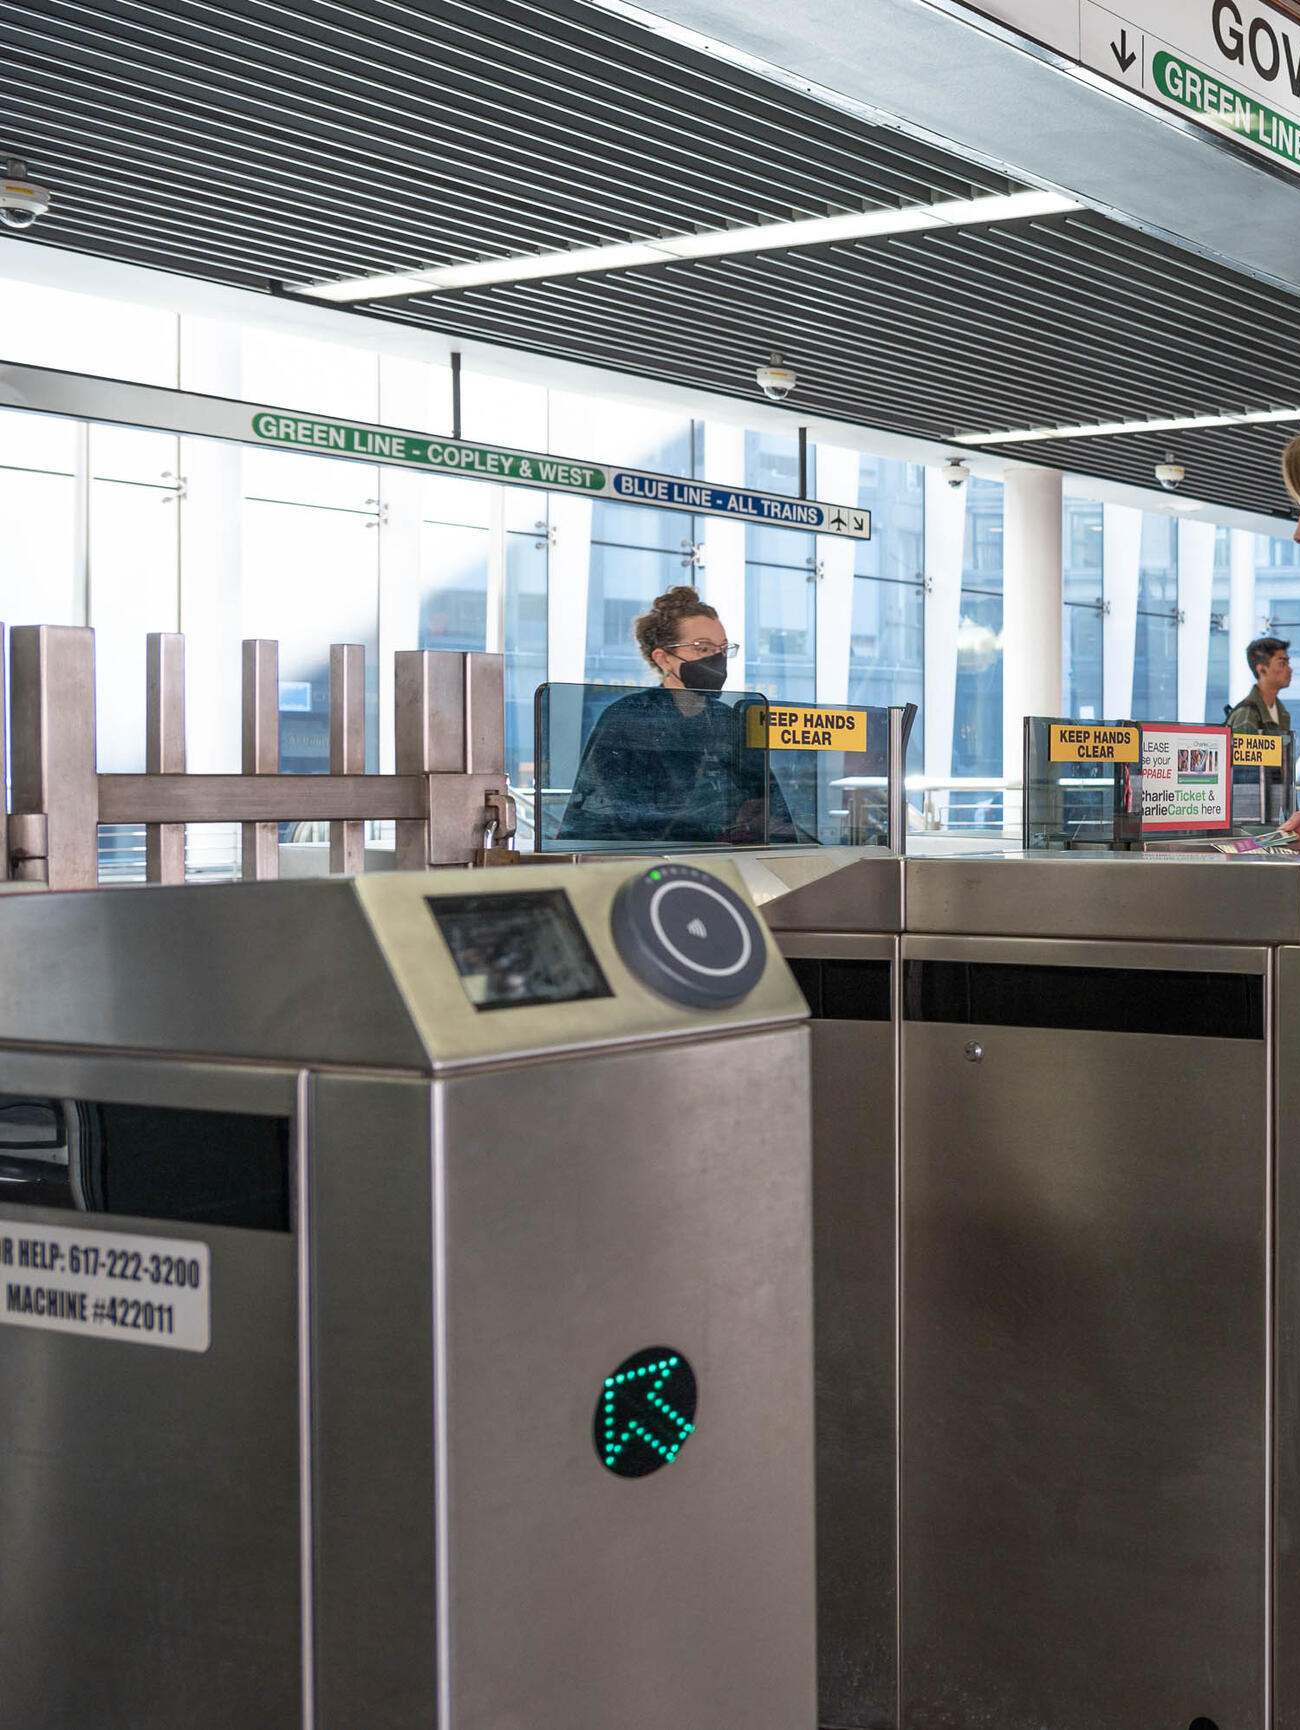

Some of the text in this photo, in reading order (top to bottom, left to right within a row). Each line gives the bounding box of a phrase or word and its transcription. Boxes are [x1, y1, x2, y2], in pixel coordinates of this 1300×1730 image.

[1164, 60, 1251, 134] GREEN
[258, 415, 346, 449] GREEN
[353, 430, 406, 458] LINE
[427, 444, 514, 475] COPLEY
[519, 458, 534, 478] &
[539, 463, 595, 488] WEST
[620, 475, 669, 500] BLUE
[673, 486, 712, 507] LINE
[726, 494, 758, 515] ALL
[760, 499, 819, 524] TRAINS
[803, 713, 856, 730] HANDS
[781, 729, 832, 746] CLEAR
[1059, 729, 1131, 745] KEEP HANDS
[1233, 737, 1276, 751] EP HANDS
[1077, 744, 1115, 758] CLEAR
[1143, 742, 1169, 753] LEASE
[1141, 756, 1171, 767] se your
[1233, 750, 1263, 763] CLEAR
[1141, 768, 1172, 779] PPABLE
[1208, 789, 1215, 802] &
[1141, 803, 1222, 817] arlieCards here
[0, 1236, 201, 1289] R HELP: 617-222-3200
[6, 1284, 175, 1335] MACHINE #422011
